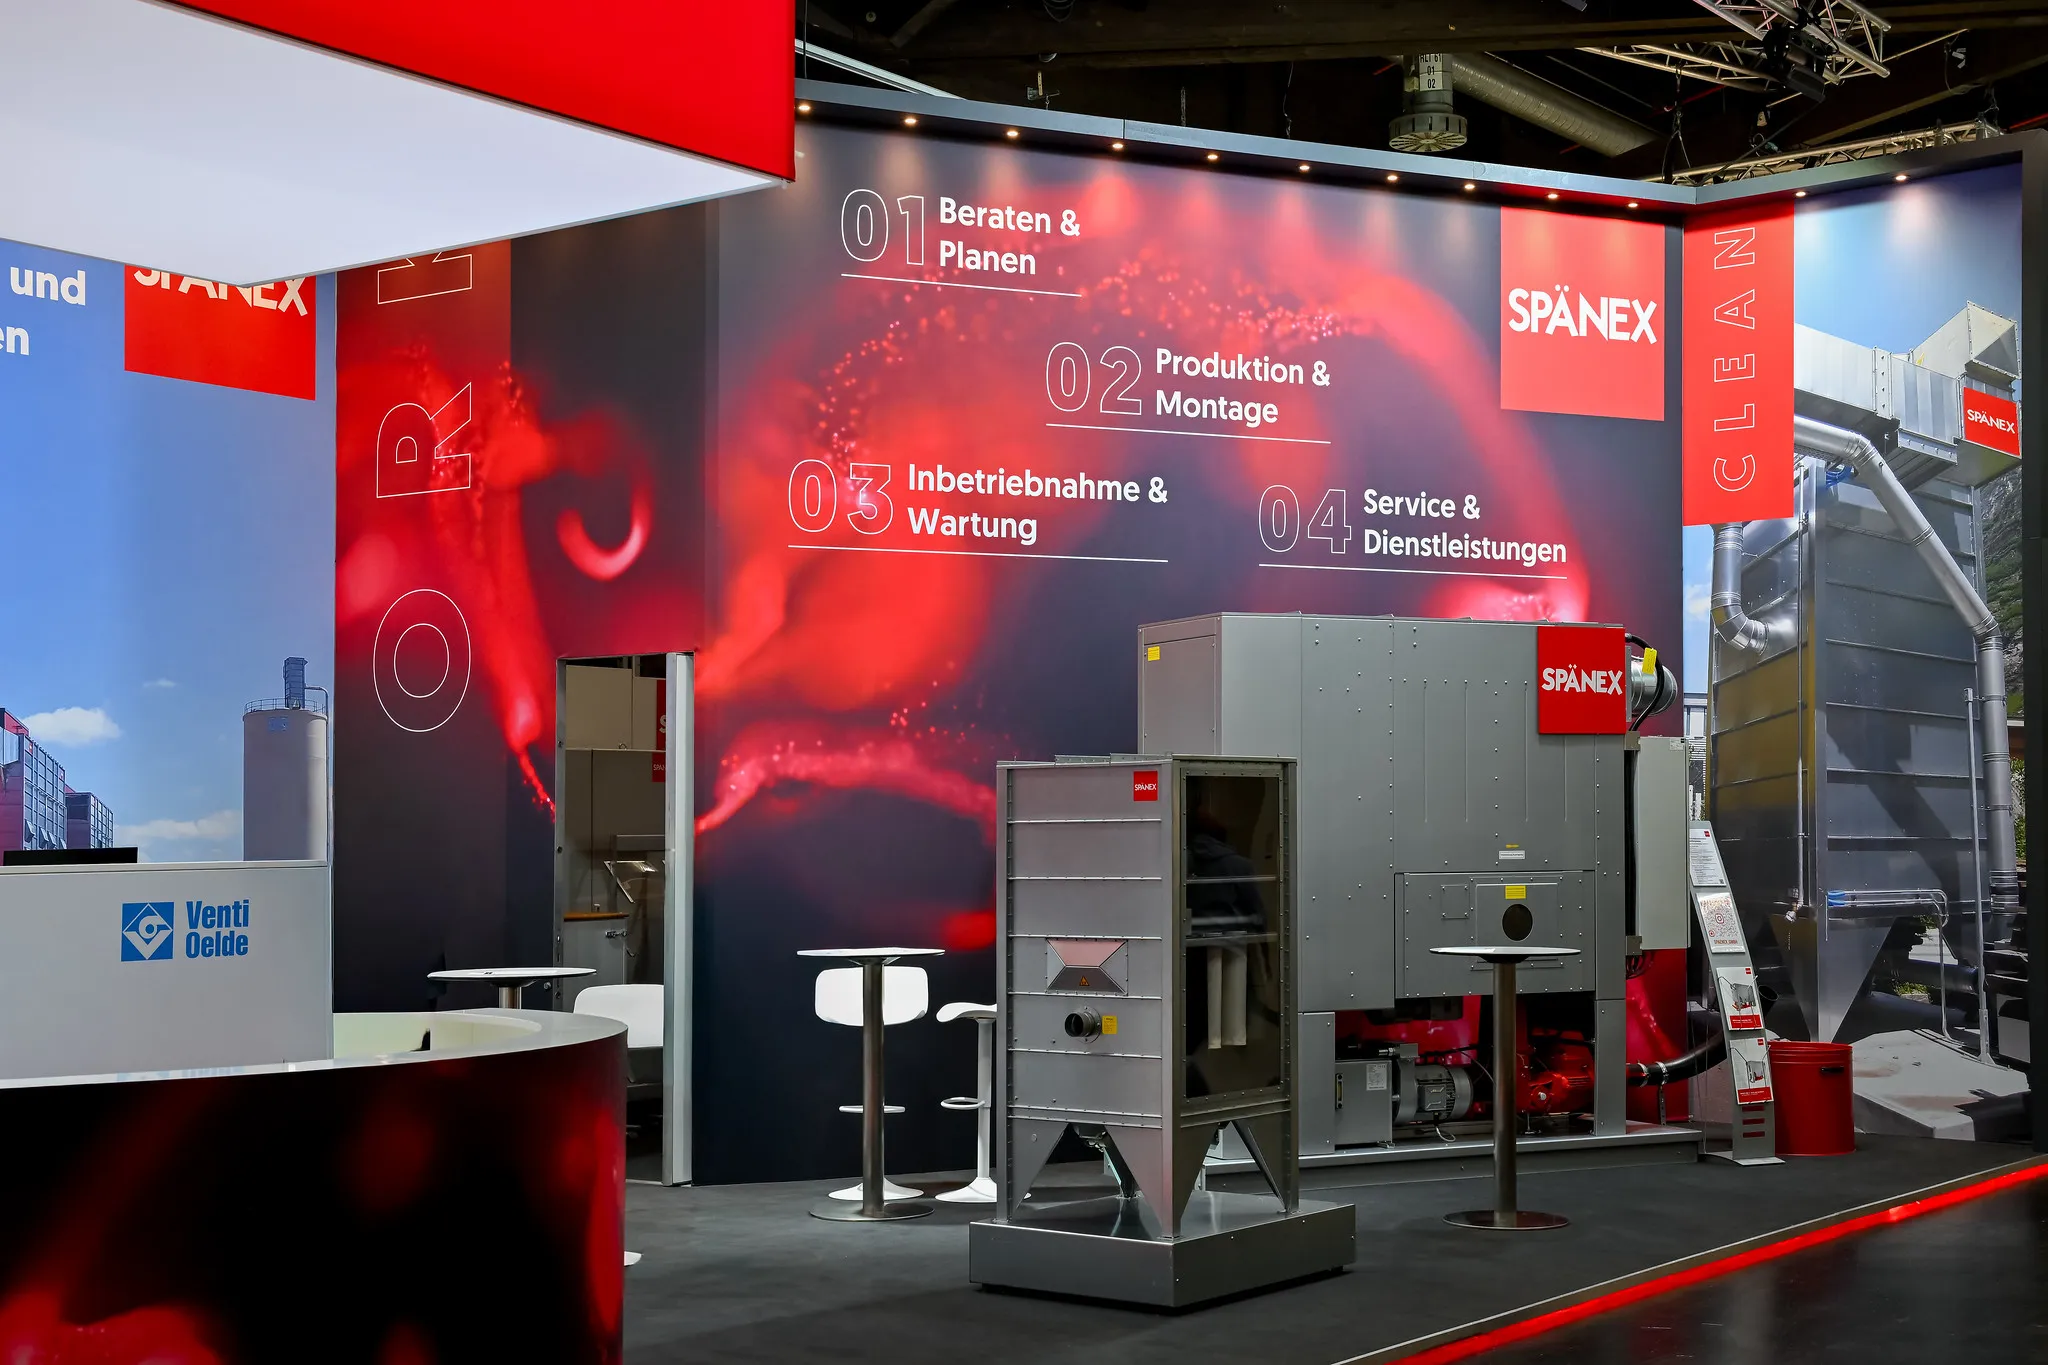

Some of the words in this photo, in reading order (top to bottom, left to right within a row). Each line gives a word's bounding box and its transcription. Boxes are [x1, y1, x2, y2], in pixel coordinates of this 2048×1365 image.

[1427, 65, 1435, 76] 01
[1427, 78, 1436, 89] 02
[841, 188, 925, 266] 01
[940, 197, 1051, 234] Beraten
[1060, 210, 1081, 237] &
[940, 240, 1036, 275] Planen
[10, 266, 86, 306] und
[1508, 284, 1658, 345] SPÄNEX
[0, 326, 29, 356] n
[1713, 226, 1756, 492] CLEAN
[1046, 341, 1142, 416] 02
[1156, 348, 1304, 385] Produktion
[1311, 360, 1331, 387] &
[1156, 390, 1279, 428] Montage
[1967, 409, 2016, 434] SPÄNEX
[788, 459, 894, 535] 03
[909, 464, 1140, 503] Inbetriebnahme
[1148, 476, 1168, 504] &
[1258, 484, 1352, 555] 04
[1363, 488, 1456, 519] Service
[1462, 494, 1481, 520] &
[908, 508, 1037, 546] Wartung
[1364, 529, 1567, 567] Dienstleistungen
[1541, 663, 1624, 696] SPÄNEX
[186, 899, 249, 930] Venti
[185, 930, 249, 959] Oelde
